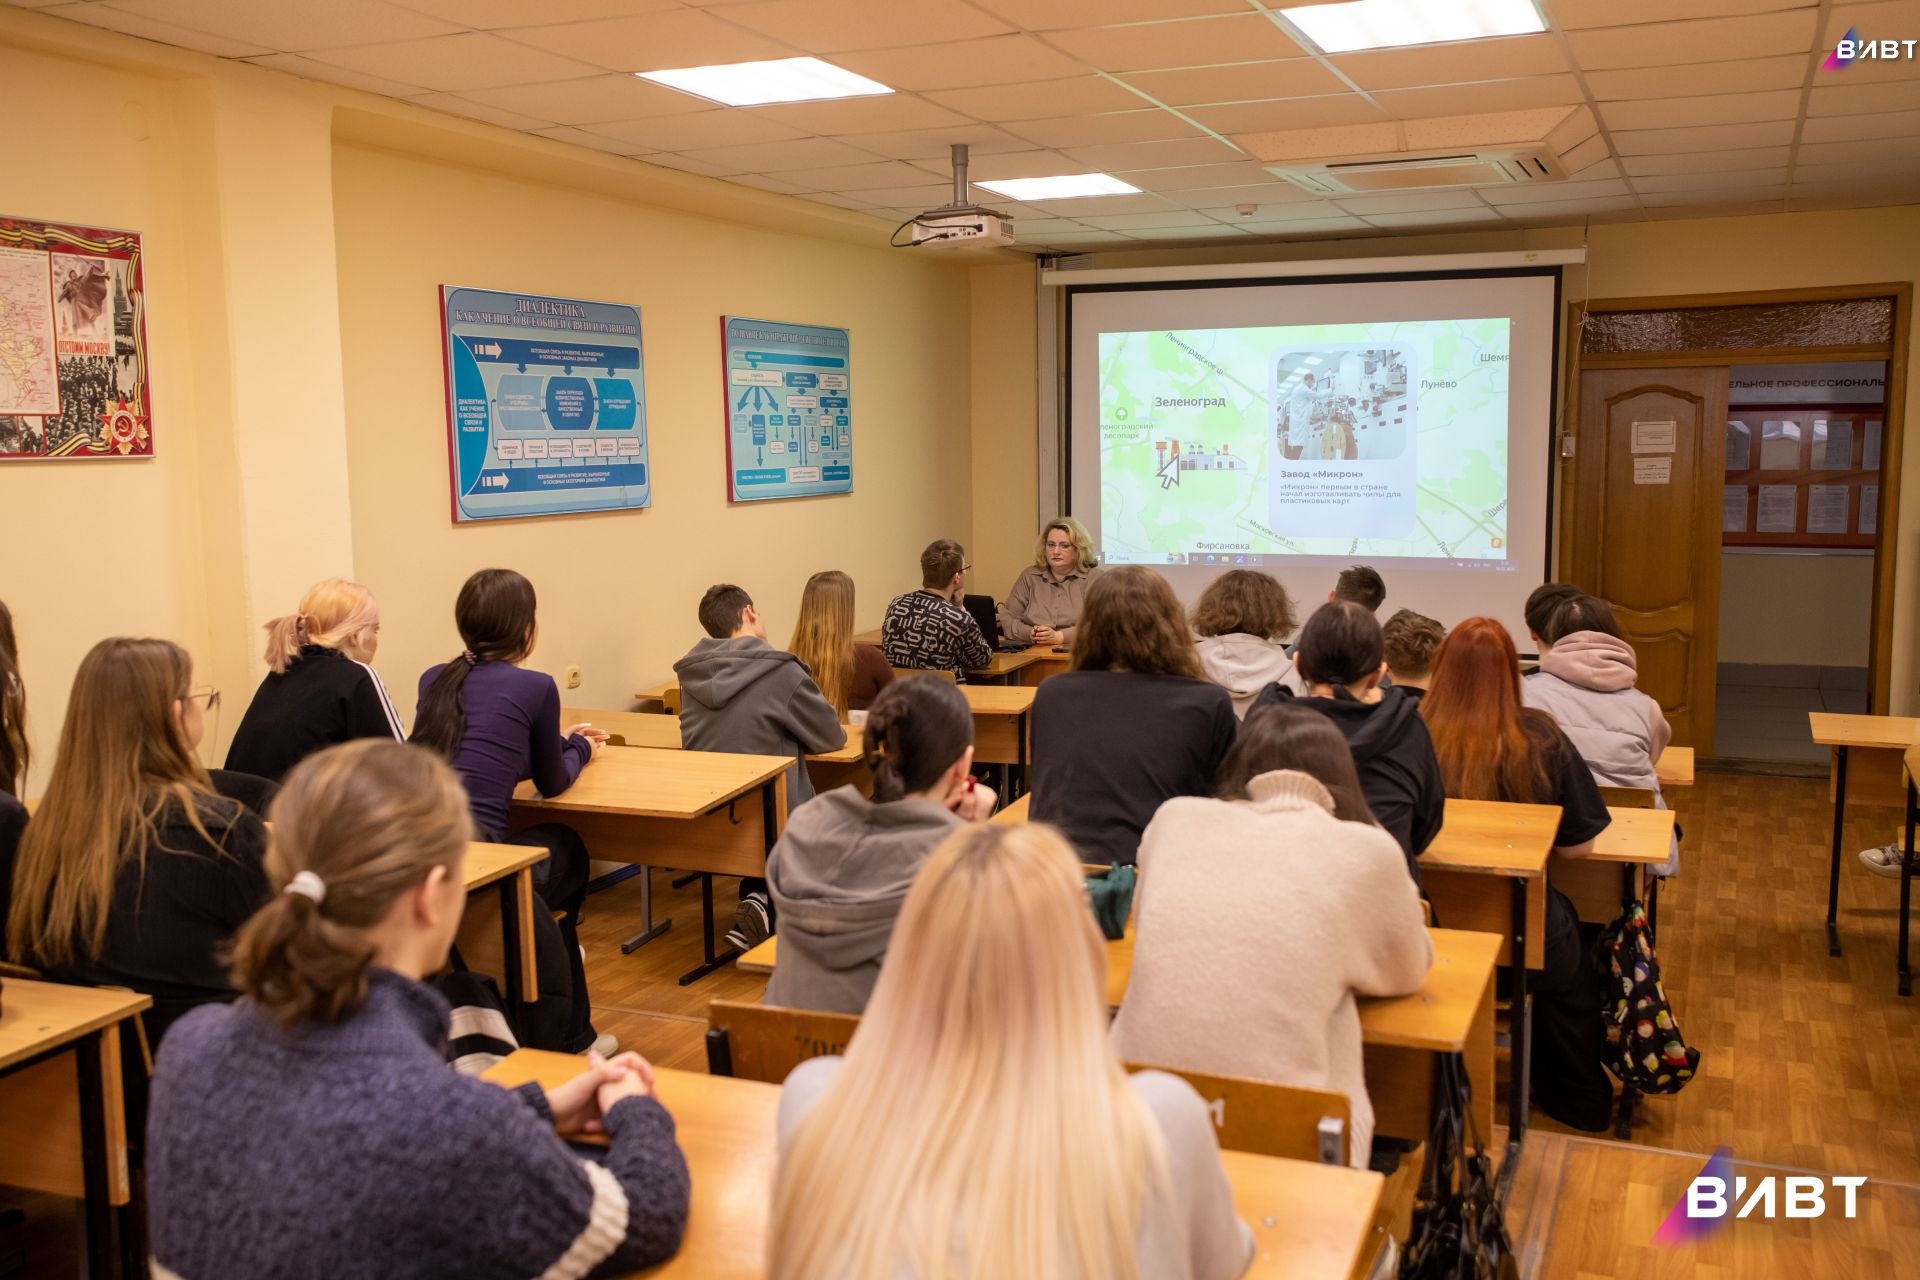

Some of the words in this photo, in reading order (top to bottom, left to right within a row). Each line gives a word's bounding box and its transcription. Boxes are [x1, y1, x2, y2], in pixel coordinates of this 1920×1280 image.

[515, 300, 585, 318] ДИАЛЕКТИКА
[456, 310, 475, 322] КАК
[58, 340, 83, 354] ОТСТОИМ
[1165, 331, 1217, 369] Ленинградское
[1420, 380, 1457, 390] Лунёво
[1155, 396, 1226, 408] Зеленоград
[1104, 432, 1139, 440] лесопарк
[1280, 470, 1310, 479] Завод
[1312, 470, 1363, 479] «Микрон»
[1196, 541, 1250, 551] Фирсановка
